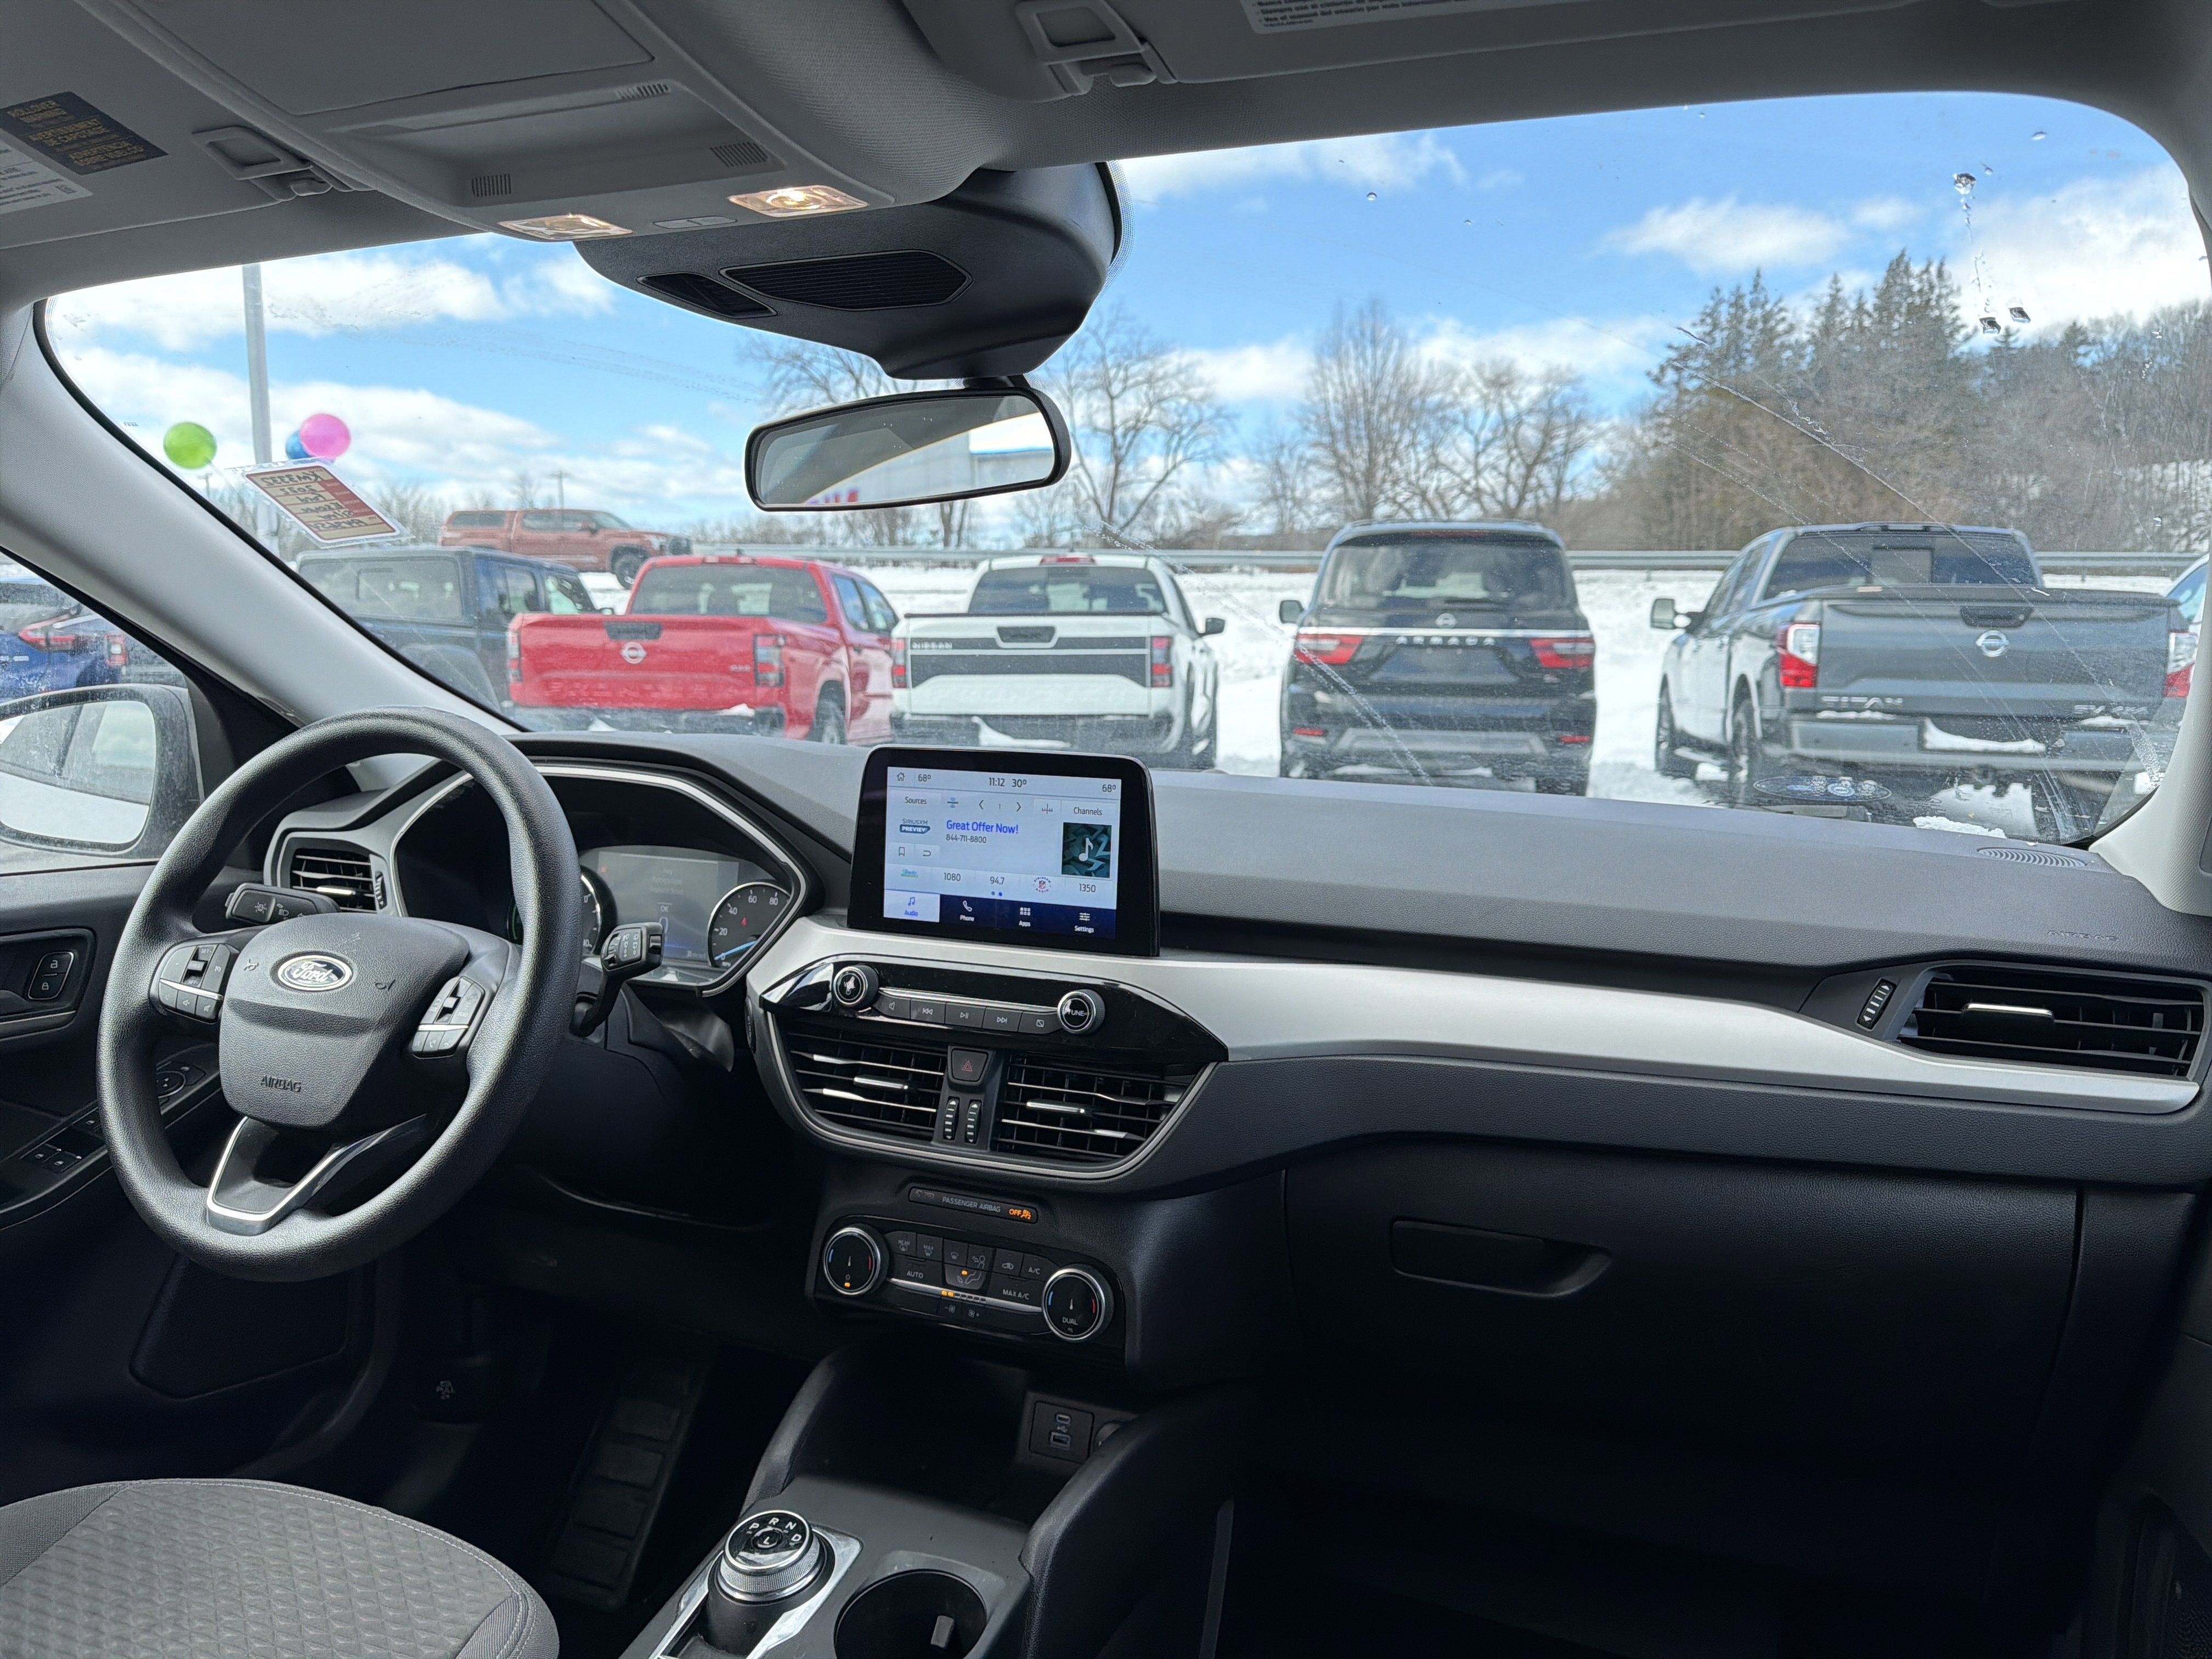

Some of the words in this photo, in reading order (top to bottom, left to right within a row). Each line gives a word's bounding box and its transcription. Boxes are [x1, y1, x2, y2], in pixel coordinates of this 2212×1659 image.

[989, 777, 1005, 787] 11:12
[905, 796, 927, 805] Sources
[1074, 806, 1103, 816] Channels
[946, 820, 969, 831] Great
[971, 821, 995, 832] Offer
[996, 823, 1018, 834] Now!
[945, 834, 987, 844] 844-711-8800
[944, 872, 961, 882] 1080
[990, 876, 1005, 885] 94.7
[1079, 883, 1096, 893] 1350
[748, 895, 757, 904] 60
[769, 897, 778, 906] 80
[728, 907, 738, 915] 40
[719, 927, 728, 936] 20
[1074, 925, 1094, 934] Settings
[292, 960, 334, 983] Ford
[261, 1075, 302, 1093] AIRBAG
[942, 1197, 978, 1209] PASSENGER
[978, 1203, 1001, 1212] AIRBAG
[906, 1270, 924, 1279] AUTO
[1028, 1267, 1041, 1275] A/C
[1002, 1289, 1016, 1298] MAX
[1017, 1291, 1030, 1300] A/C
[1062, 1317, 1079, 1326] DUAL
[769, 1517, 780, 1526] R
[785, 1521, 797, 1530] N
[791, 1533, 802, 1542] D
